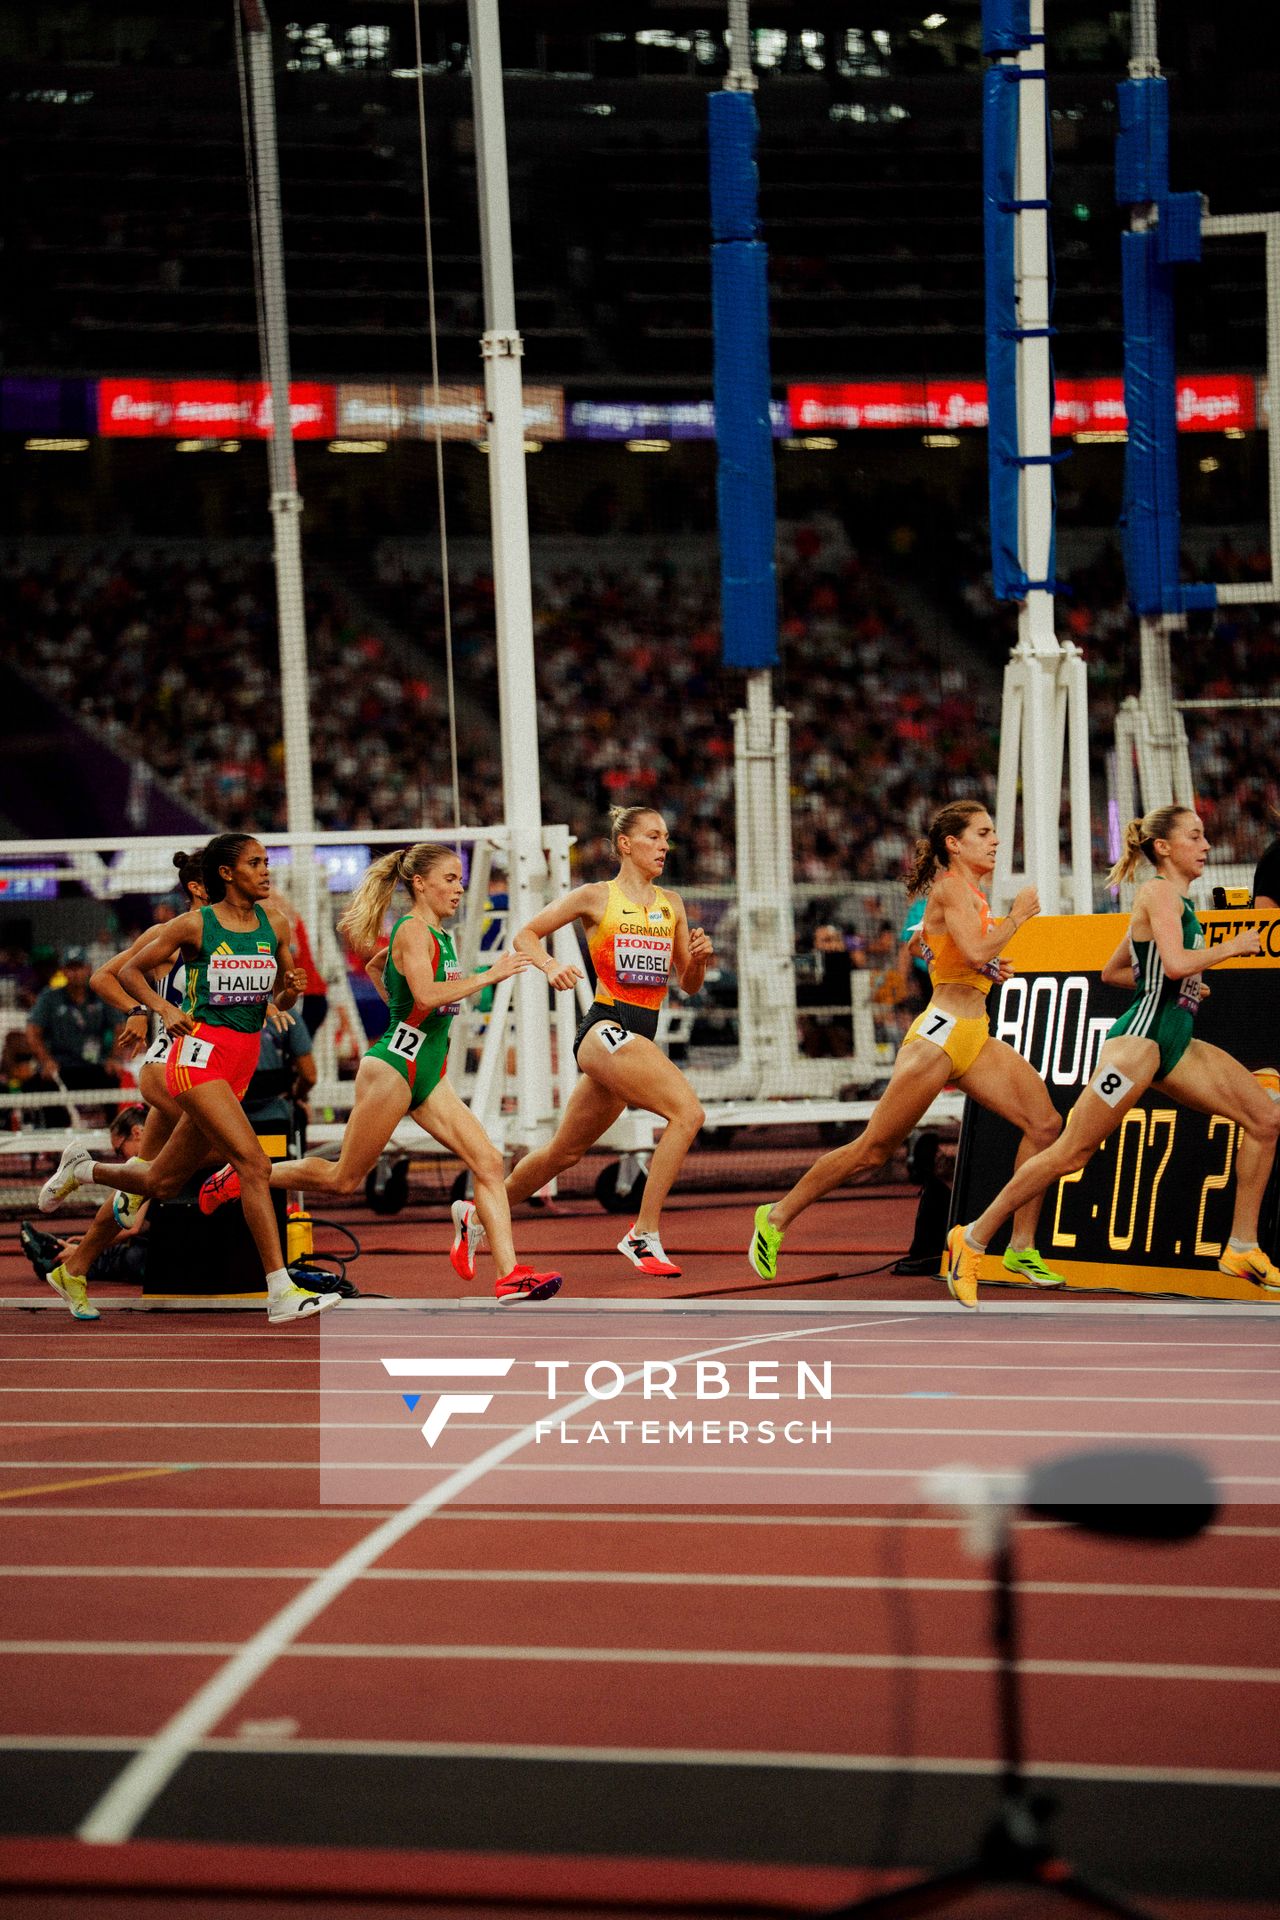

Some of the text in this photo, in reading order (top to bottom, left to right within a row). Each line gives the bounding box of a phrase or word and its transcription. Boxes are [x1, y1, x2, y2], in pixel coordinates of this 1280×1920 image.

[619, 923, 672, 937] GERMANY
[616, 939, 671, 951] HONDA
[211, 960, 276, 969] HONDA
[218, 976, 271, 991] HAILU
[926, 1014, 948, 1036] 7
[394, 1027, 419, 1057] 12
[600, 1026, 629, 1047] 13
[154, 1038, 168, 1058] 2
[191, 1042, 202, 1063] 1
[1100, 1072, 1122, 1095] 8
[1052, 1107, 1245, 1257] 2:07.2
